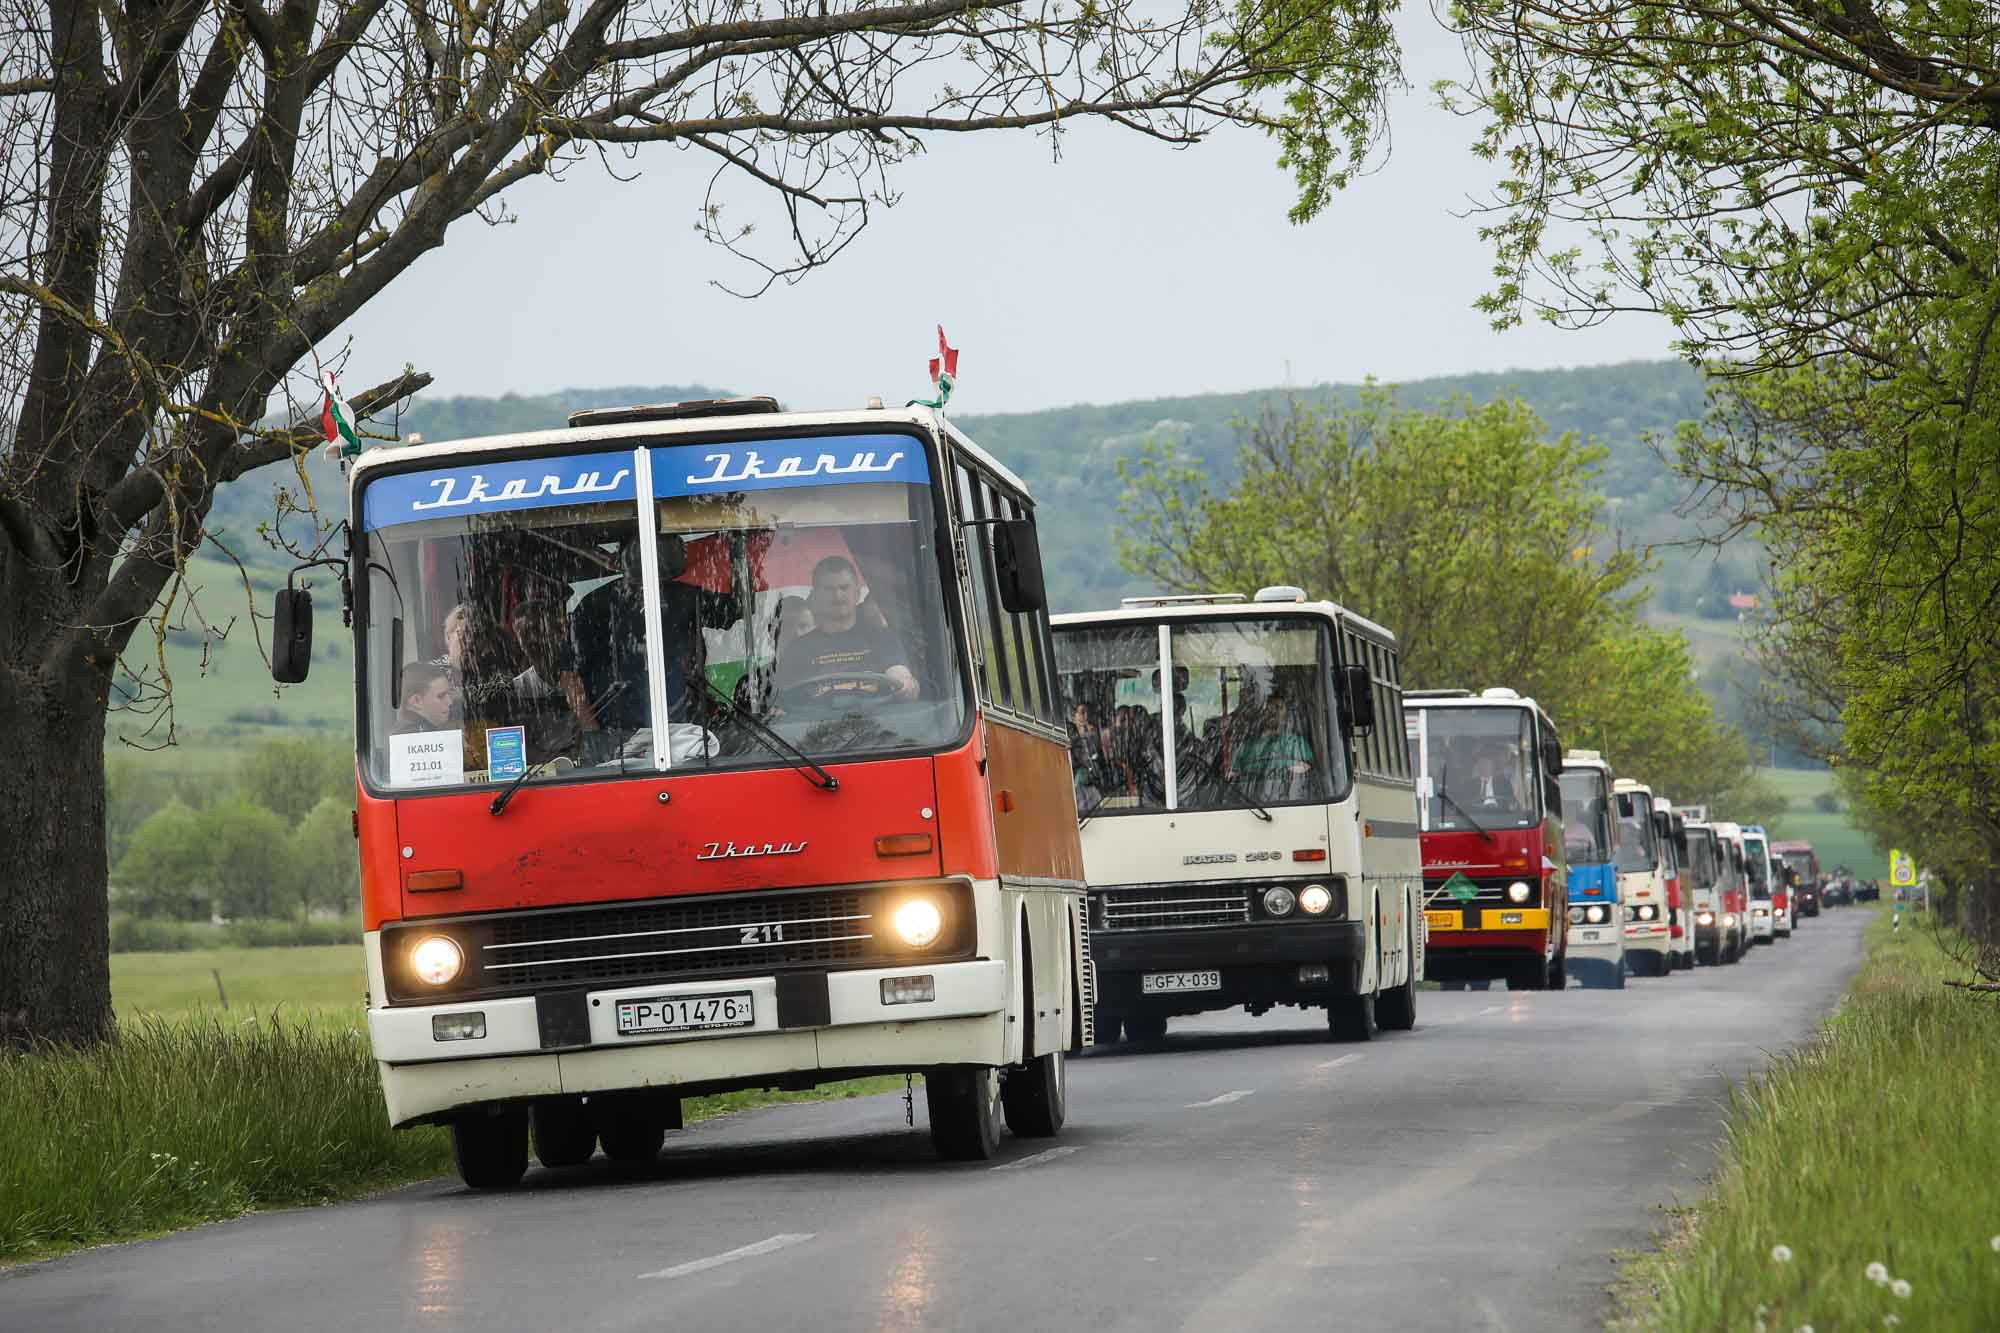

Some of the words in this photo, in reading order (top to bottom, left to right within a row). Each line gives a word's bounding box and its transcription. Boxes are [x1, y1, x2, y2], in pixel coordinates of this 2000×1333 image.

[687, 452, 904, 484] Ikarus
[413, 469, 629, 510] Ikarus
[407, 743, 445, 755] IKARUS
[410, 760, 442, 772] 211.01
[696, 841, 808, 860] Ikarus
[1183, 853, 1237, 865] IKARUS
[1155, 972, 1218, 988] GFX-039
[636, 998, 737, 1027] P-01476
[738, 1004, 750, 1014] 21
